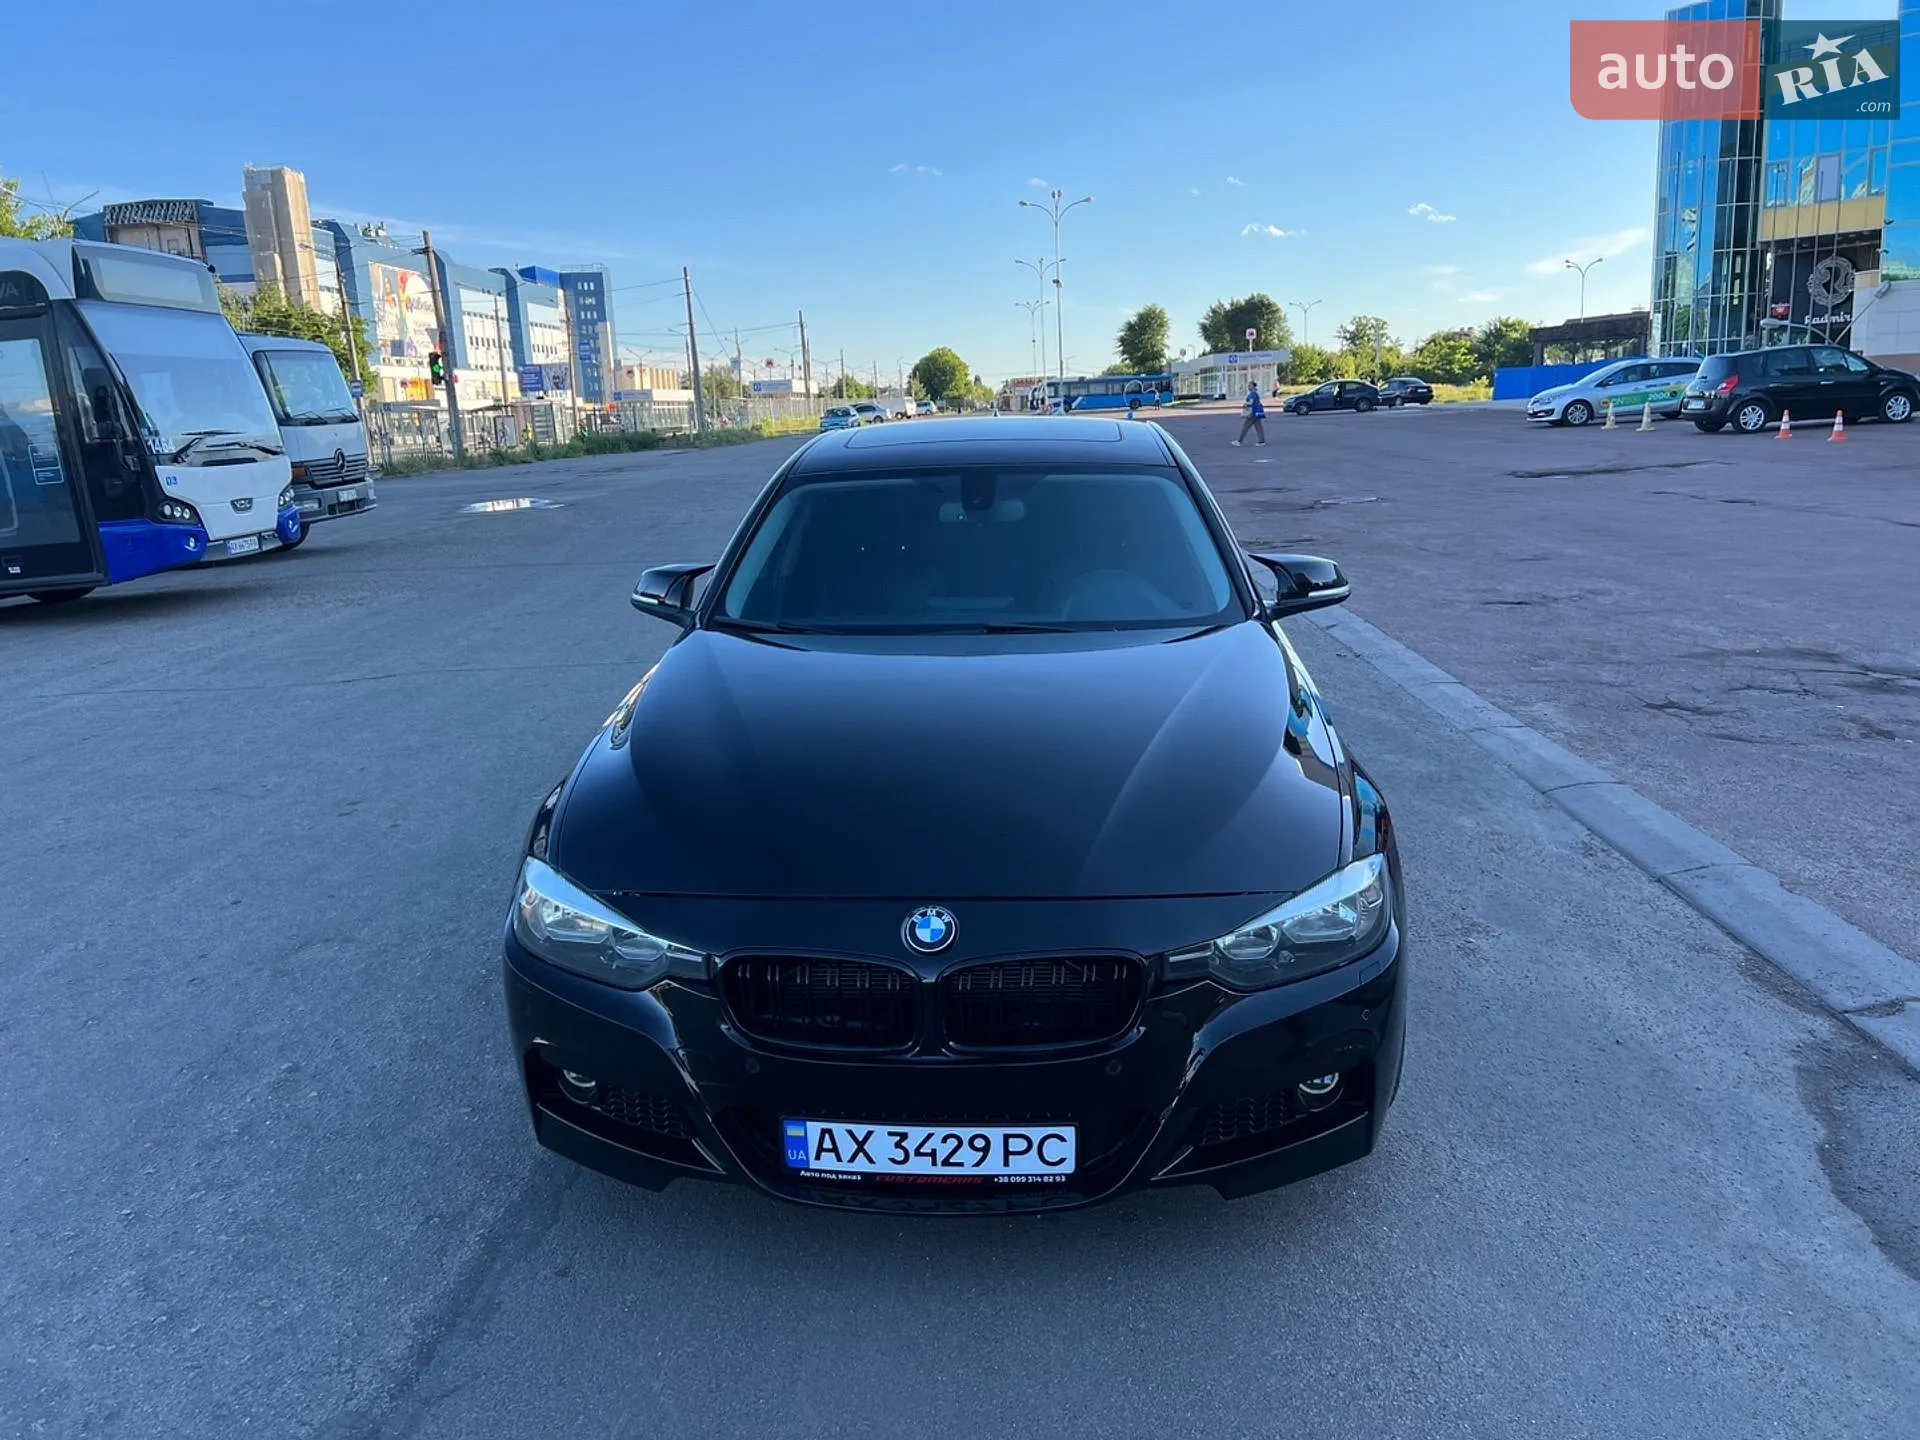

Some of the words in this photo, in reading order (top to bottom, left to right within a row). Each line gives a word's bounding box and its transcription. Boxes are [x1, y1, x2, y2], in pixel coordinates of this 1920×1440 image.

[788, 1149, 807, 1160] UA
[814, 1127, 876, 1165] AX
[887, 1131, 992, 1168] 3429
[1002, 1133, 1068, 1168] PC
